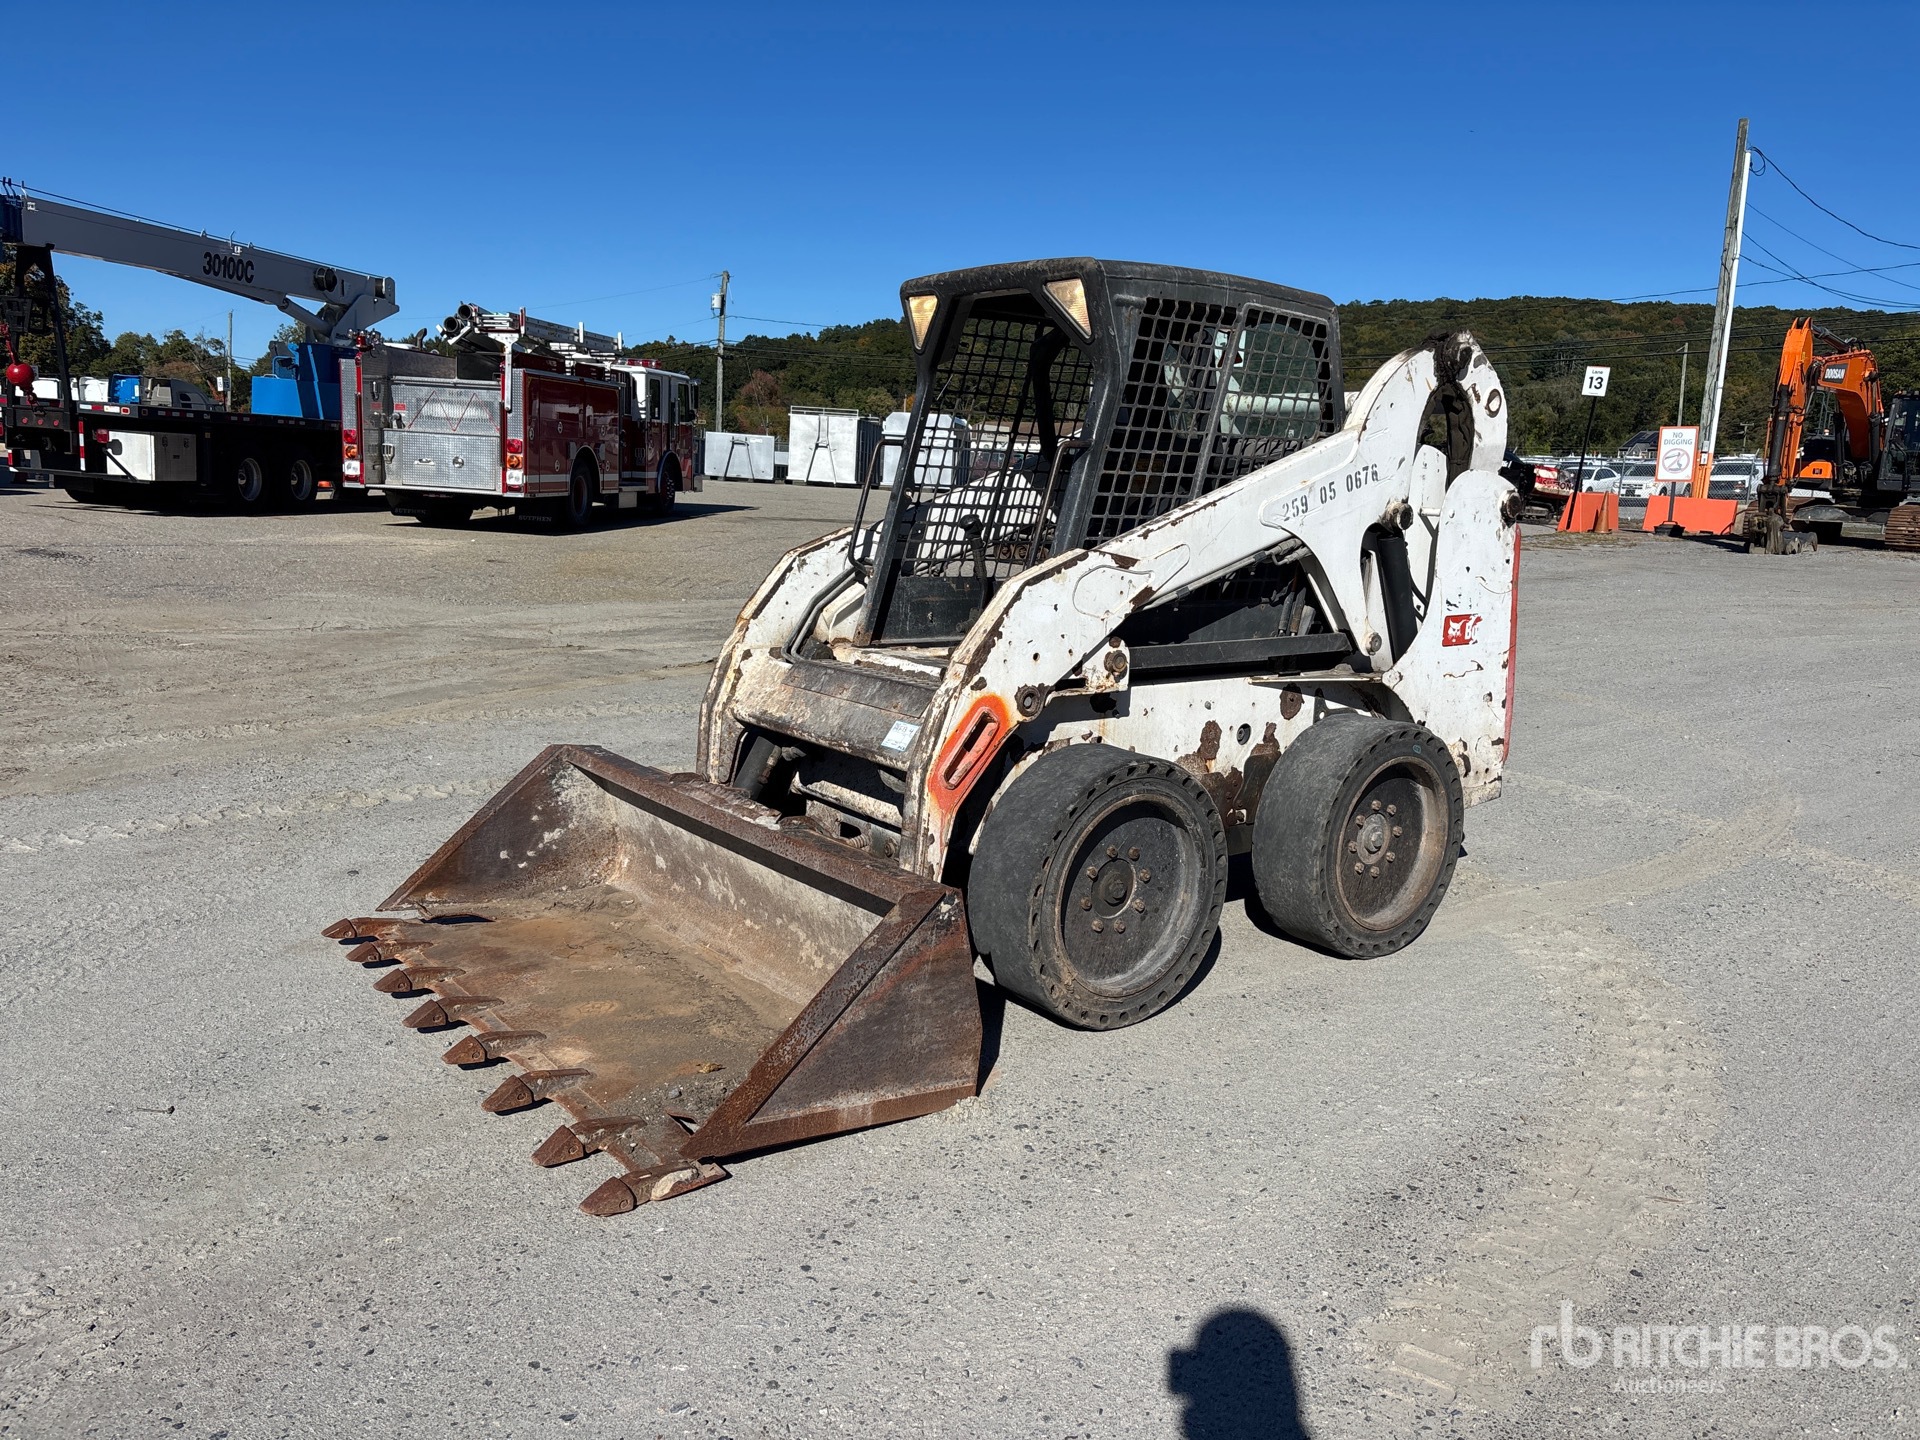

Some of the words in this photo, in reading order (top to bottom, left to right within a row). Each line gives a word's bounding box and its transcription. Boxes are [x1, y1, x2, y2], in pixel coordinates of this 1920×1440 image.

[203, 251, 255, 284] 30100C
[1825, 368, 1846, 379] DOOSAN
[1588, 376, 1604, 390] 13
[1672, 431, 1684, 439] NO
[1663, 438, 1693, 446] DIGGING
[1281, 494, 1309, 522] 259
[1319, 481, 1337, 505] 05
[1345, 463, 1379, 493] 0676
